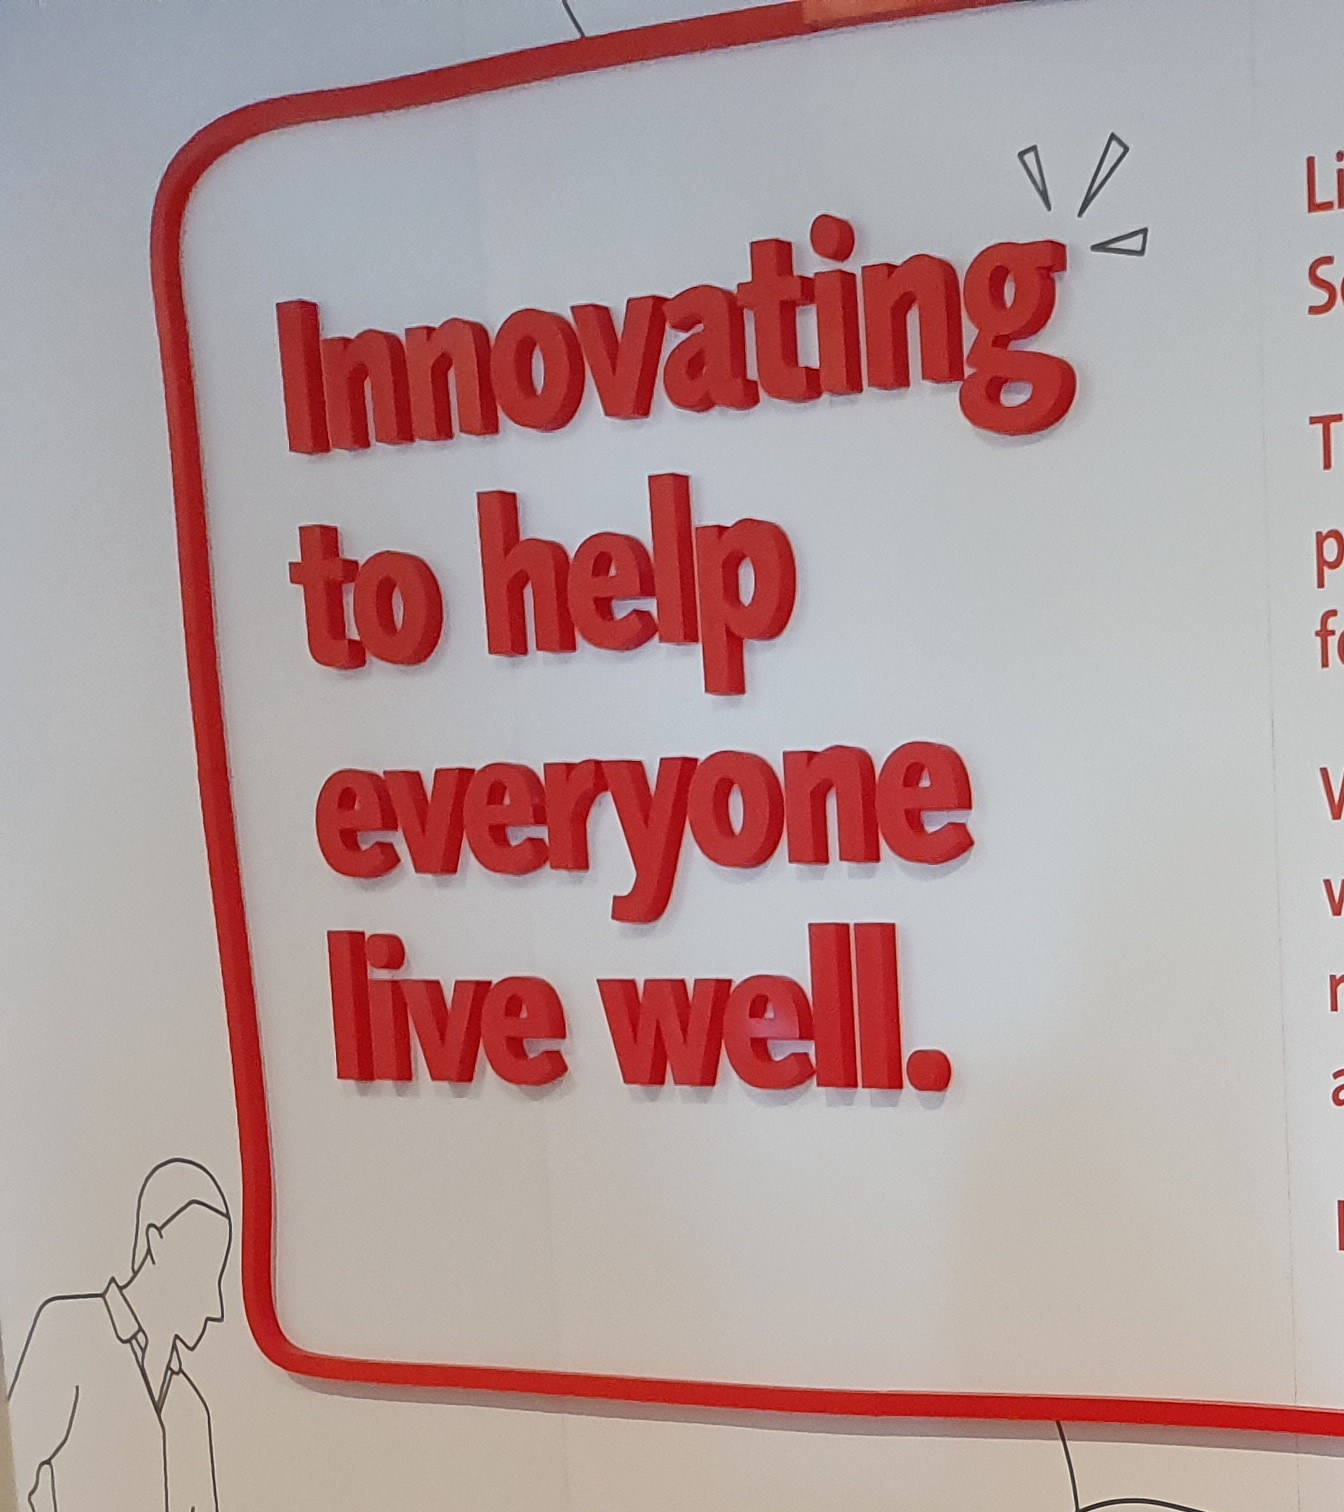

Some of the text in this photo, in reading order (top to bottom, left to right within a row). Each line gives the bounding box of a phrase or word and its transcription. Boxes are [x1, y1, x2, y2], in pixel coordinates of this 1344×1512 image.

[278, 215, 1077, 455] Innovating
[289, 473, 798, 695] to help
[316, 742, 975, 924] everyone
[327, 923, 954, 1093] live well.
